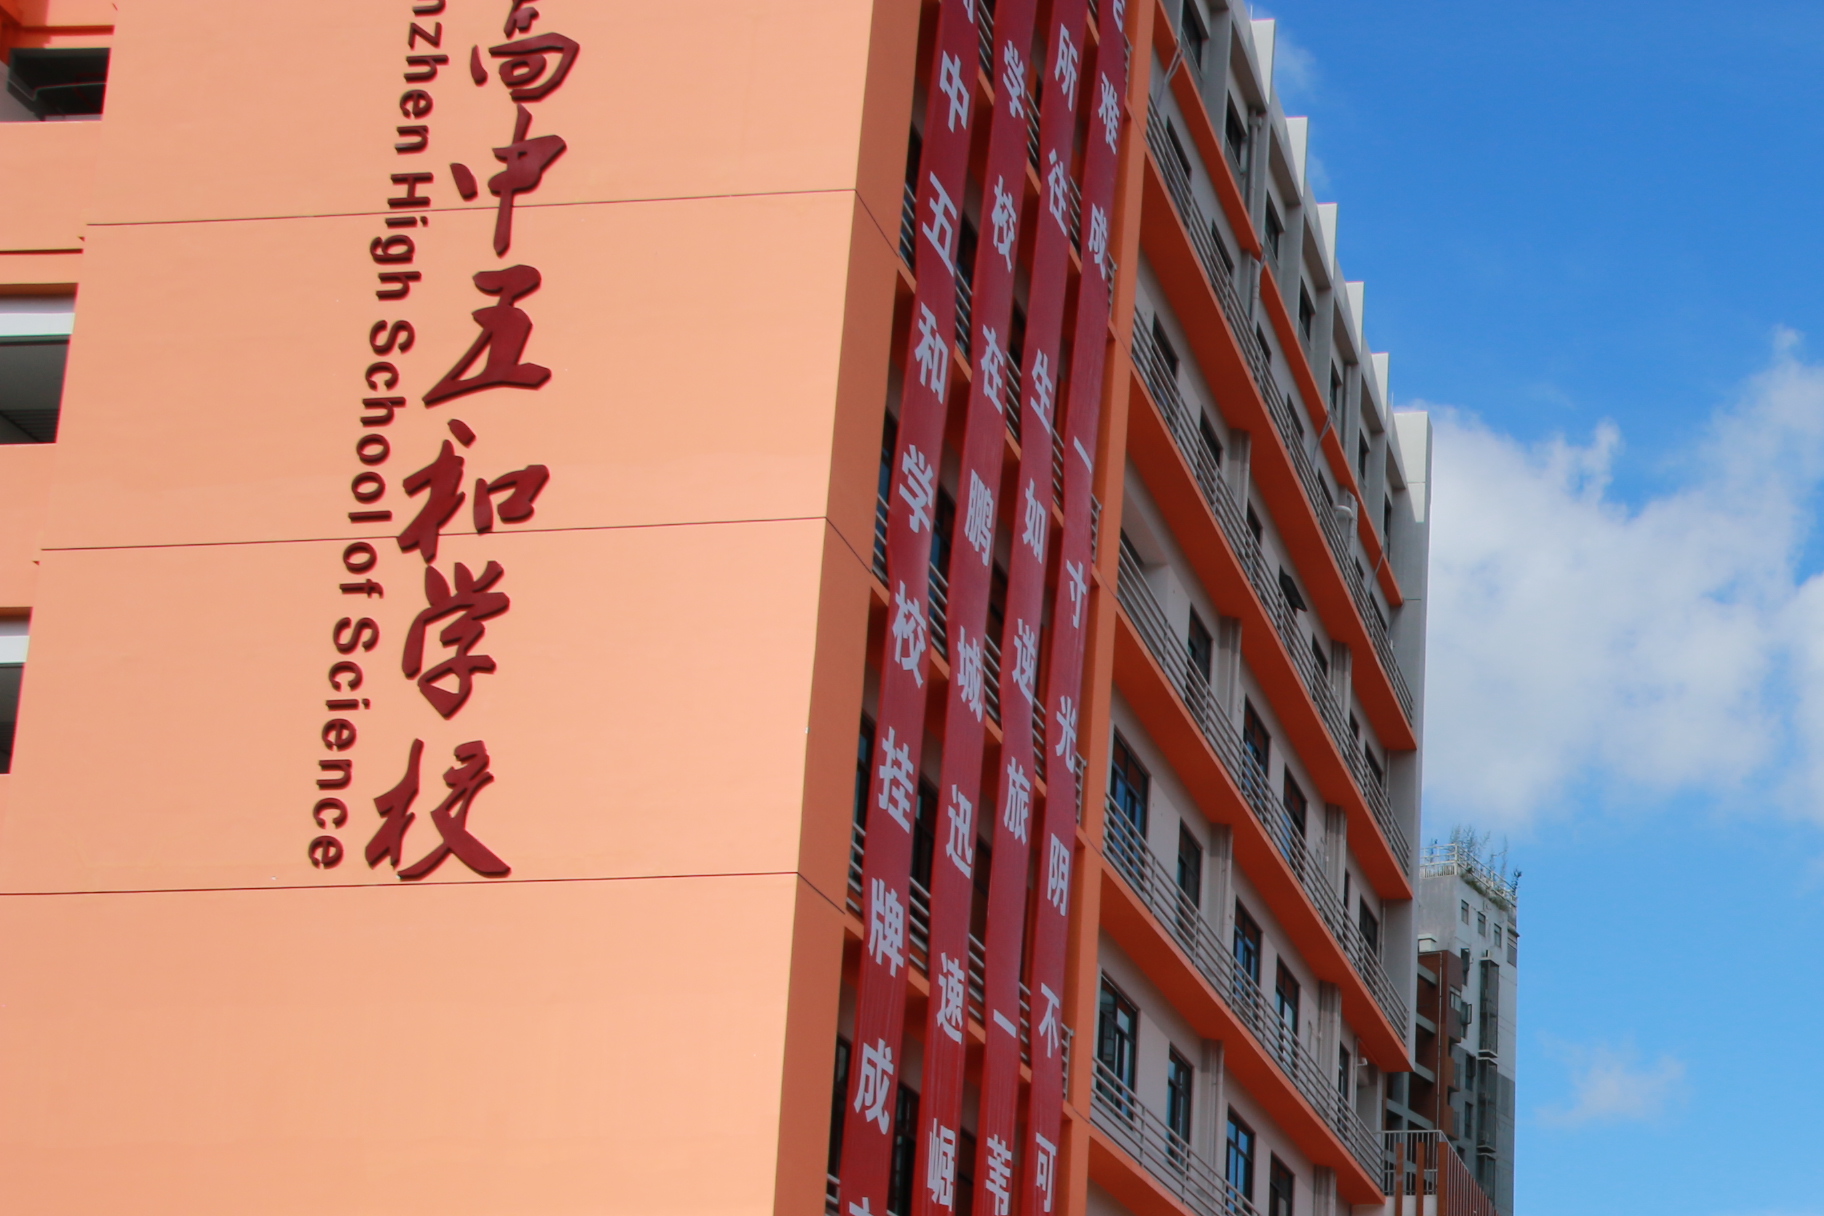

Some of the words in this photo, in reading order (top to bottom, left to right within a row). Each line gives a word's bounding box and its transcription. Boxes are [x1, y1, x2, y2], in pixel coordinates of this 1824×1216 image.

[369, 172, 434, 301] High
[347, 319, 416, 524] School
[364, 0, 580, 881] 高中五和学校
[339, 541, 383, 599] of
[308, 616, 381, 871] Science
